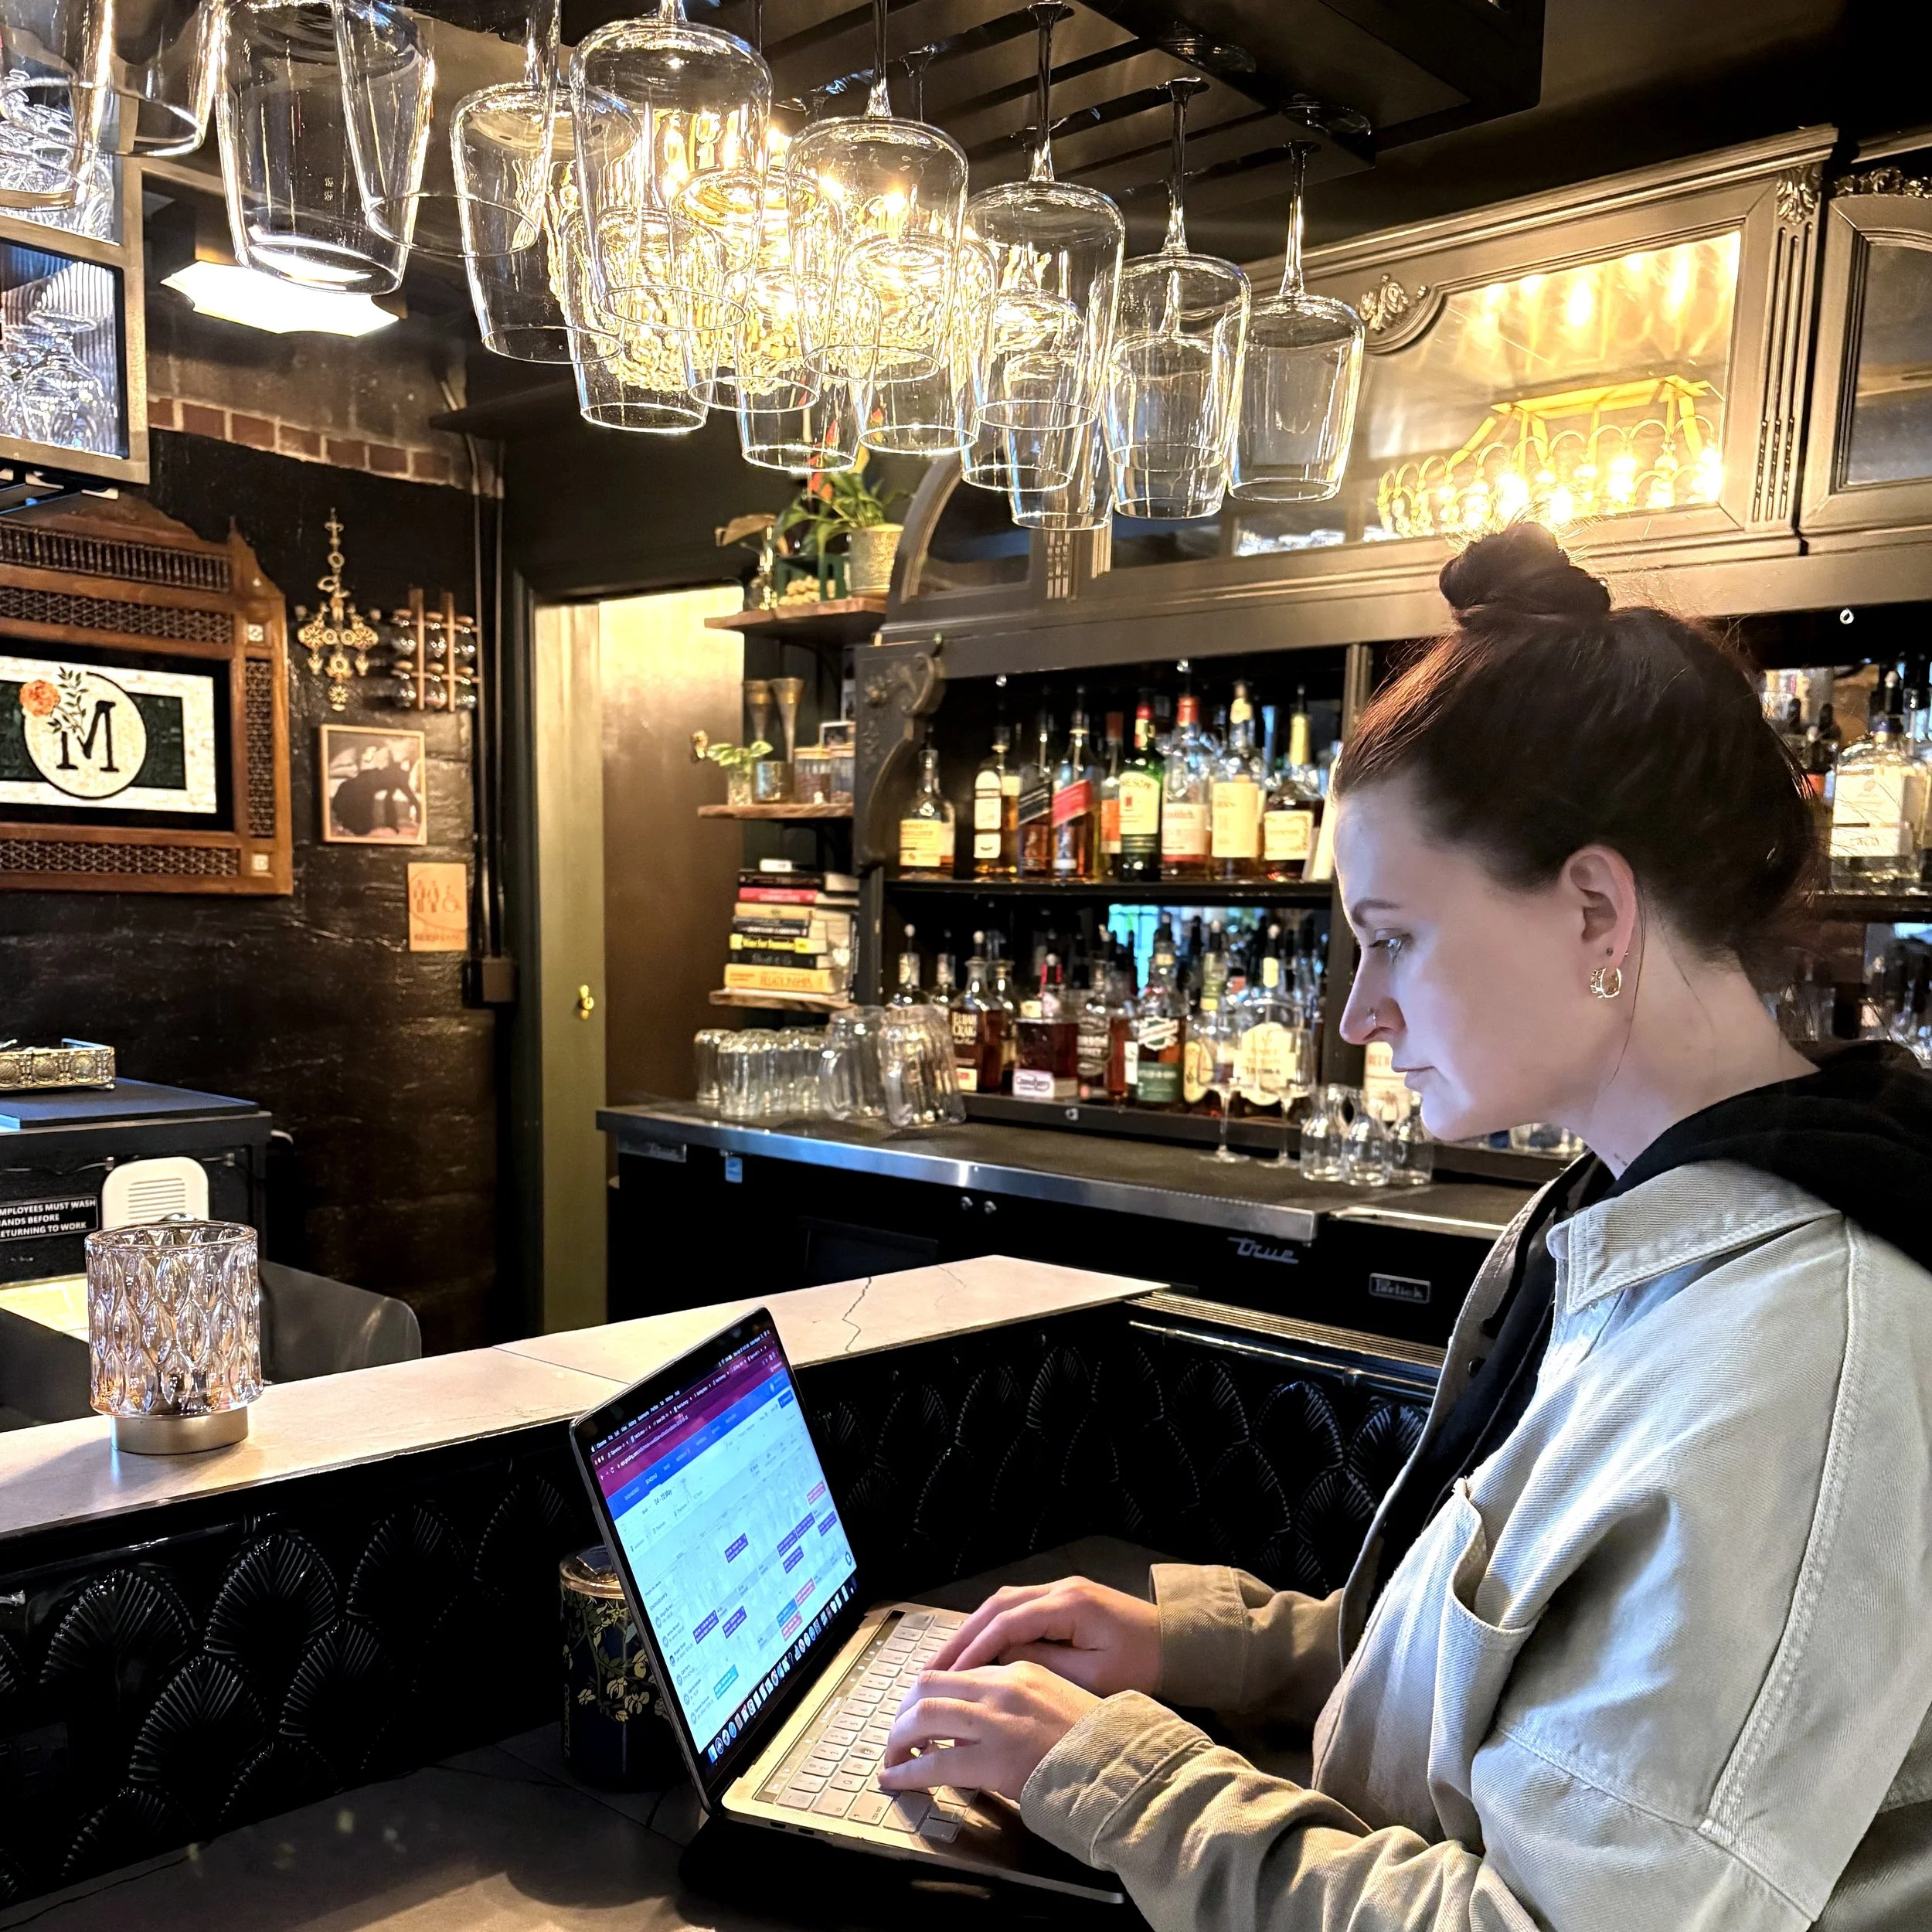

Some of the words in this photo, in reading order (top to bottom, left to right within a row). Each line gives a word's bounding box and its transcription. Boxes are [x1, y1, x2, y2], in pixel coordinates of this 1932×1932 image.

[56, 700, 120, 773] M
[0, 1204, 43, 1216] MPLOYEES
[45, 1202, 70, 1211] MUST
[70, 1199, 96, 1209] WASH
[0, 1218, 26, 1226] ANDS
[28, 1213, 60, 1224] BEFORE
[0, 1225, 46, 1238] ETURNING
[47, 1223, 60, 1233] TO
[60, 1221, 87, 1231] WORK
